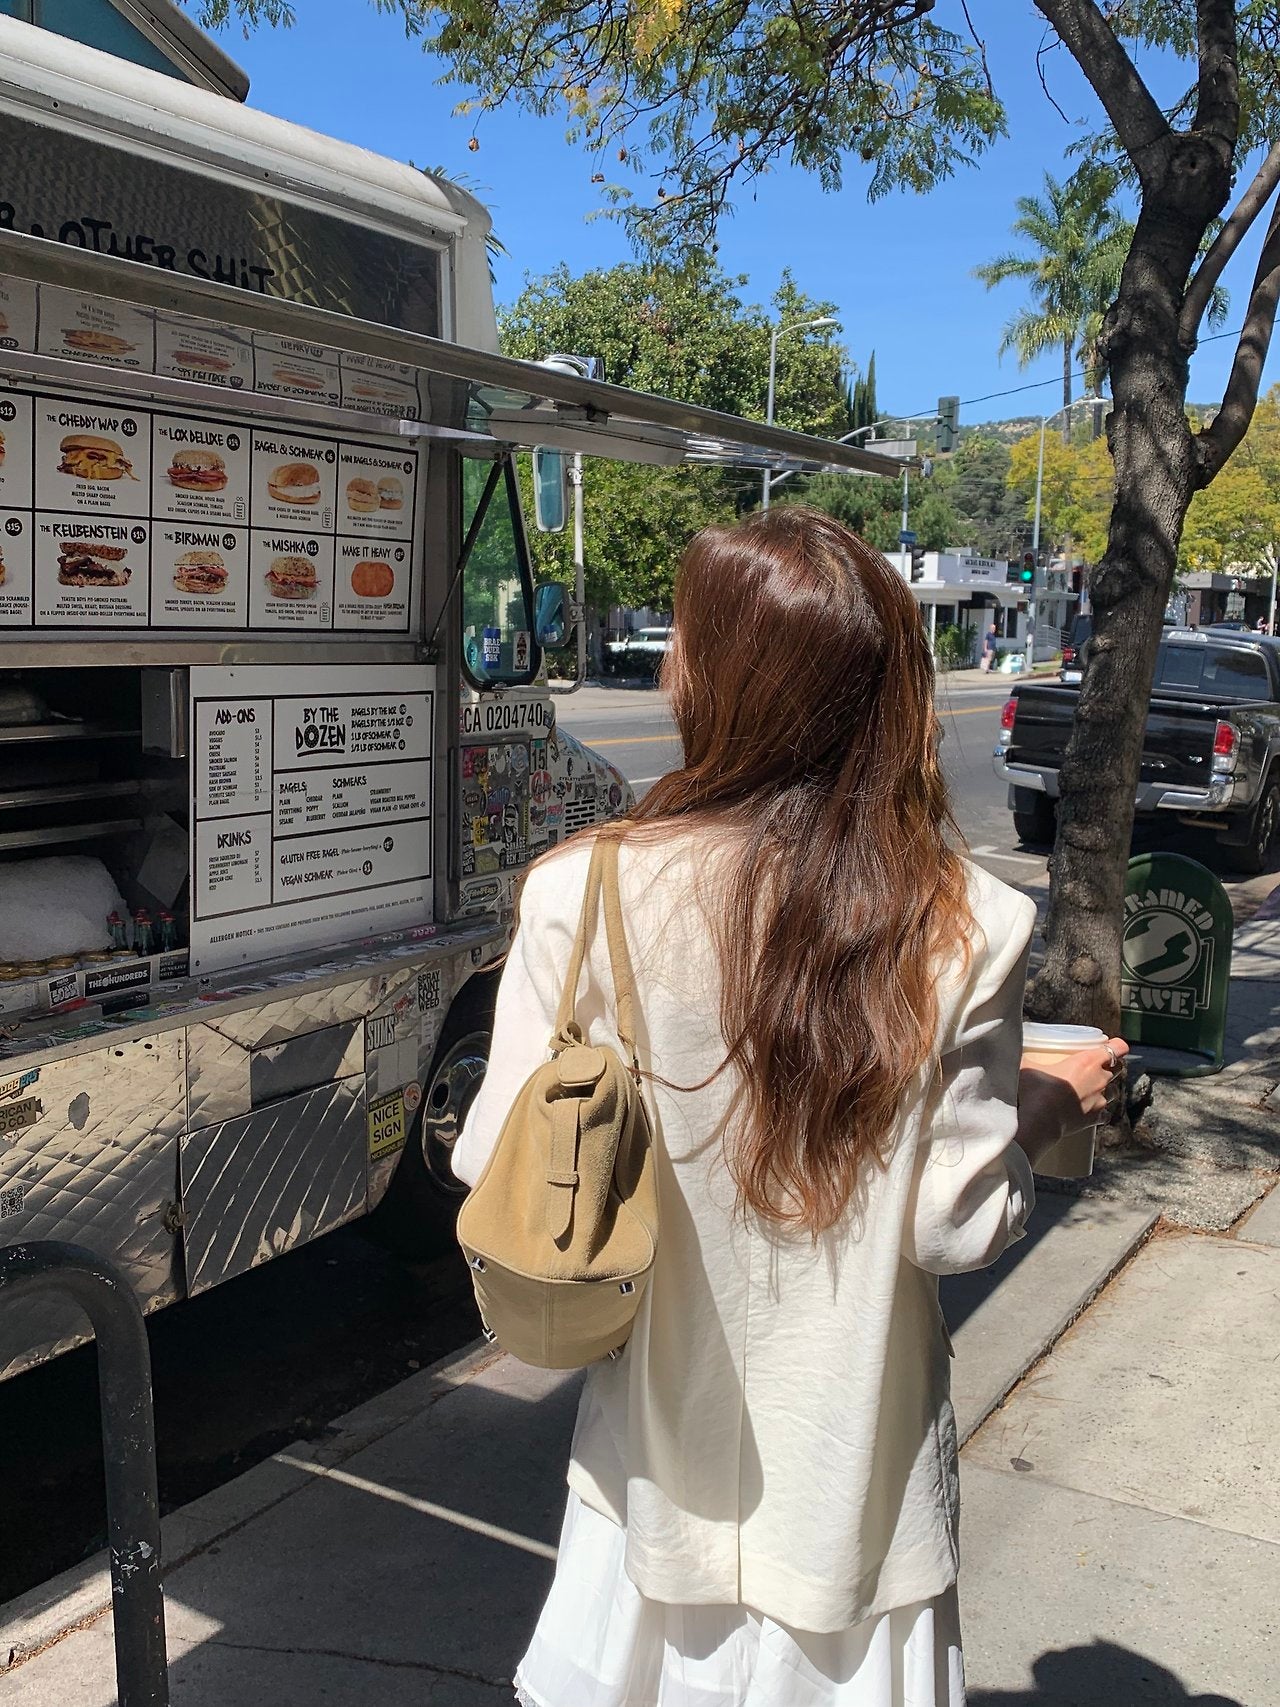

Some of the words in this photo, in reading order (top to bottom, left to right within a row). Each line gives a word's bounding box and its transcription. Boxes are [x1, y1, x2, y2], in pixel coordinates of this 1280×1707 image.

[60, 217, 177, 272] OTHER
[47, 414, 57, 422] THE
[59, 413, 98, 430] CHEDDY
[98, 418, 120, 432] WAP
[159, 428, 169, 436] THE
[169, 427, 189, 442] LOX
[189, 429, 225, 447] DELUXE
[254, 440, 279, 454] BAGEL
[280, 444, 288, 455] &
[289, 445, 325, 461] SCHMEAR
[40, 525, 51, 533] THE
[52, 523, 129, 540] REUBENSTEIN
[164, 533, 174, 541] THE
[174, 531, 220, 547] BIRDMAN
[271, 539, 306, 554] MISHKA
[342, 546, 361, 557] MAKE
[362, 547, 370, 558] IT
[371, 548, 391, 559] HEAVY
[215, 708, 256, 725] ADD-ONS
[303, 708, 318, 723] BY
[319, 707, 340, 722] THE
[351, 707, 371, 717] BAGELS
[371, 707, 380, 716] BY
[379, 706, 389, 716] THE
[464, 707, 482, 733] CA
[487, 703, 543, 731] 0204740
[351, 718, 371, 729] BAGELS
[370, 718, 379, 728] BY
[378, 717, 387, 727] THE
[295, 724, 346, 750] DOZEN
[368, 730, 392, 741] SCHMEAR
[374, 741, 397, 751] SCHMEAR
[279, 782, 307, 794] BAGELS
[332, 775, 368, 789] SCHMEARS
[306, 795, 323, 803] CHEDDAR
[332, 801, 349, 809] SCALLION
[279, 807, 302, 816] EVERYTHING
[306, 805, 319, 813] POPPY
[279, 818, 294, 826] SESAME
[306, 813, 326, 822] BLUEBERRY
[217, 830, 252, 849] DRINKS
[280, 852, 305, 865] GLUTEN
[306, 849, 322, 861] FREE
[322, 848, 341, 860] BAGEL
[280, 873, 303, 887] VEGAN
[304, 870, 334, 884] SCHMEAR
[1123, 888, 1214, 931] RAMED
[210, 931, 235, 943] ALLERGEN
[235, 929, 253, 940] NOTICE
[88, 978, 102, 989] THE
[108, 969, 149, 986] HUNDREDS
[417, 970, 441, 982] SPRAY
[417, 979, 441, 991] PAINT
[418, 987, 440, 1003] NOT
[418, 997, 440, 1012] WEED
[9, 1115, 28, 1128] CO.
[373, 1102, 400, 1126] NICE
[373, 1119, 402, 1144] SIGN
